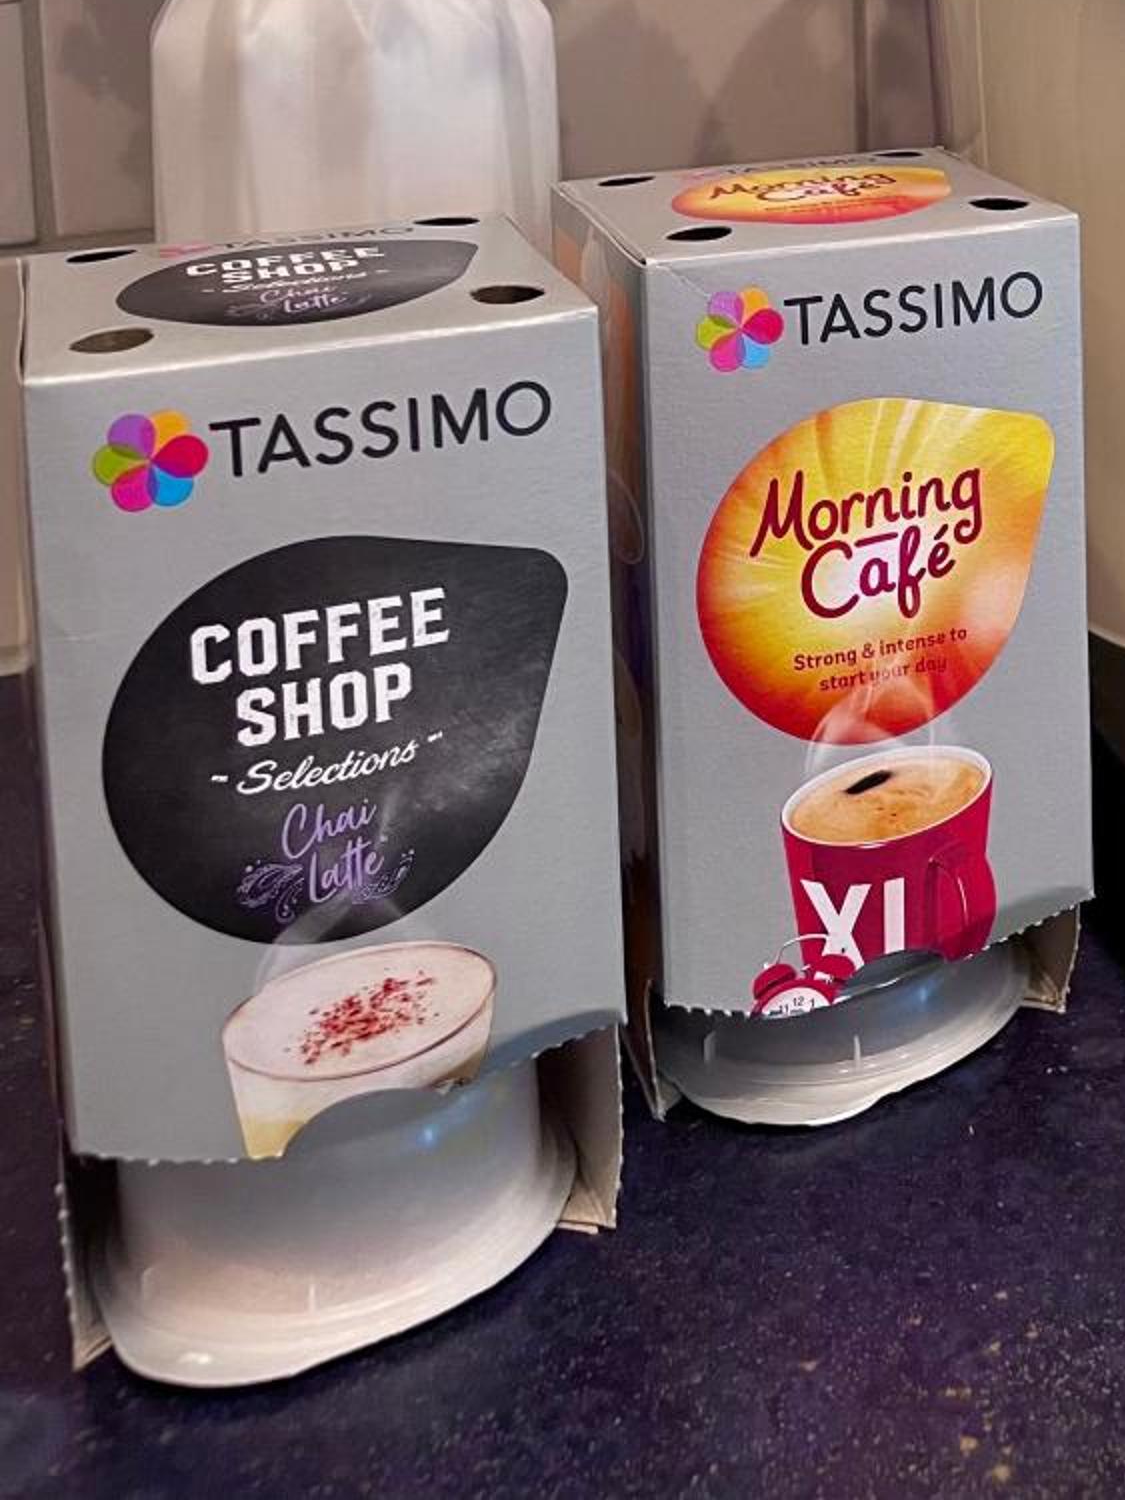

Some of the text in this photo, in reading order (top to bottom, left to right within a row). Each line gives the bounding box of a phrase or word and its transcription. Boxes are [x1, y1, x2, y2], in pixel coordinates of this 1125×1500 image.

[186, 247, 385, 276] COFFEE
[221, 260, 360, 283] SHOP
[783, 270, 1043, 346] TASSIMO
[208, 380, 552, 478] TASSIMO
[749, 467, 984, 558] Morning
[800, 523, 955, 620] Café
[190, 587, 450, 684] COFFEE
[793, 627, 967, 671] Strong & intense to
[235, 662, 413, 748] SHOP
[819, 656, 947, 692] start your day
[236, 739, 419, 795] Selections
[282, 798, 377, 859] Chai
[309, 835, 384, 903] Latte
